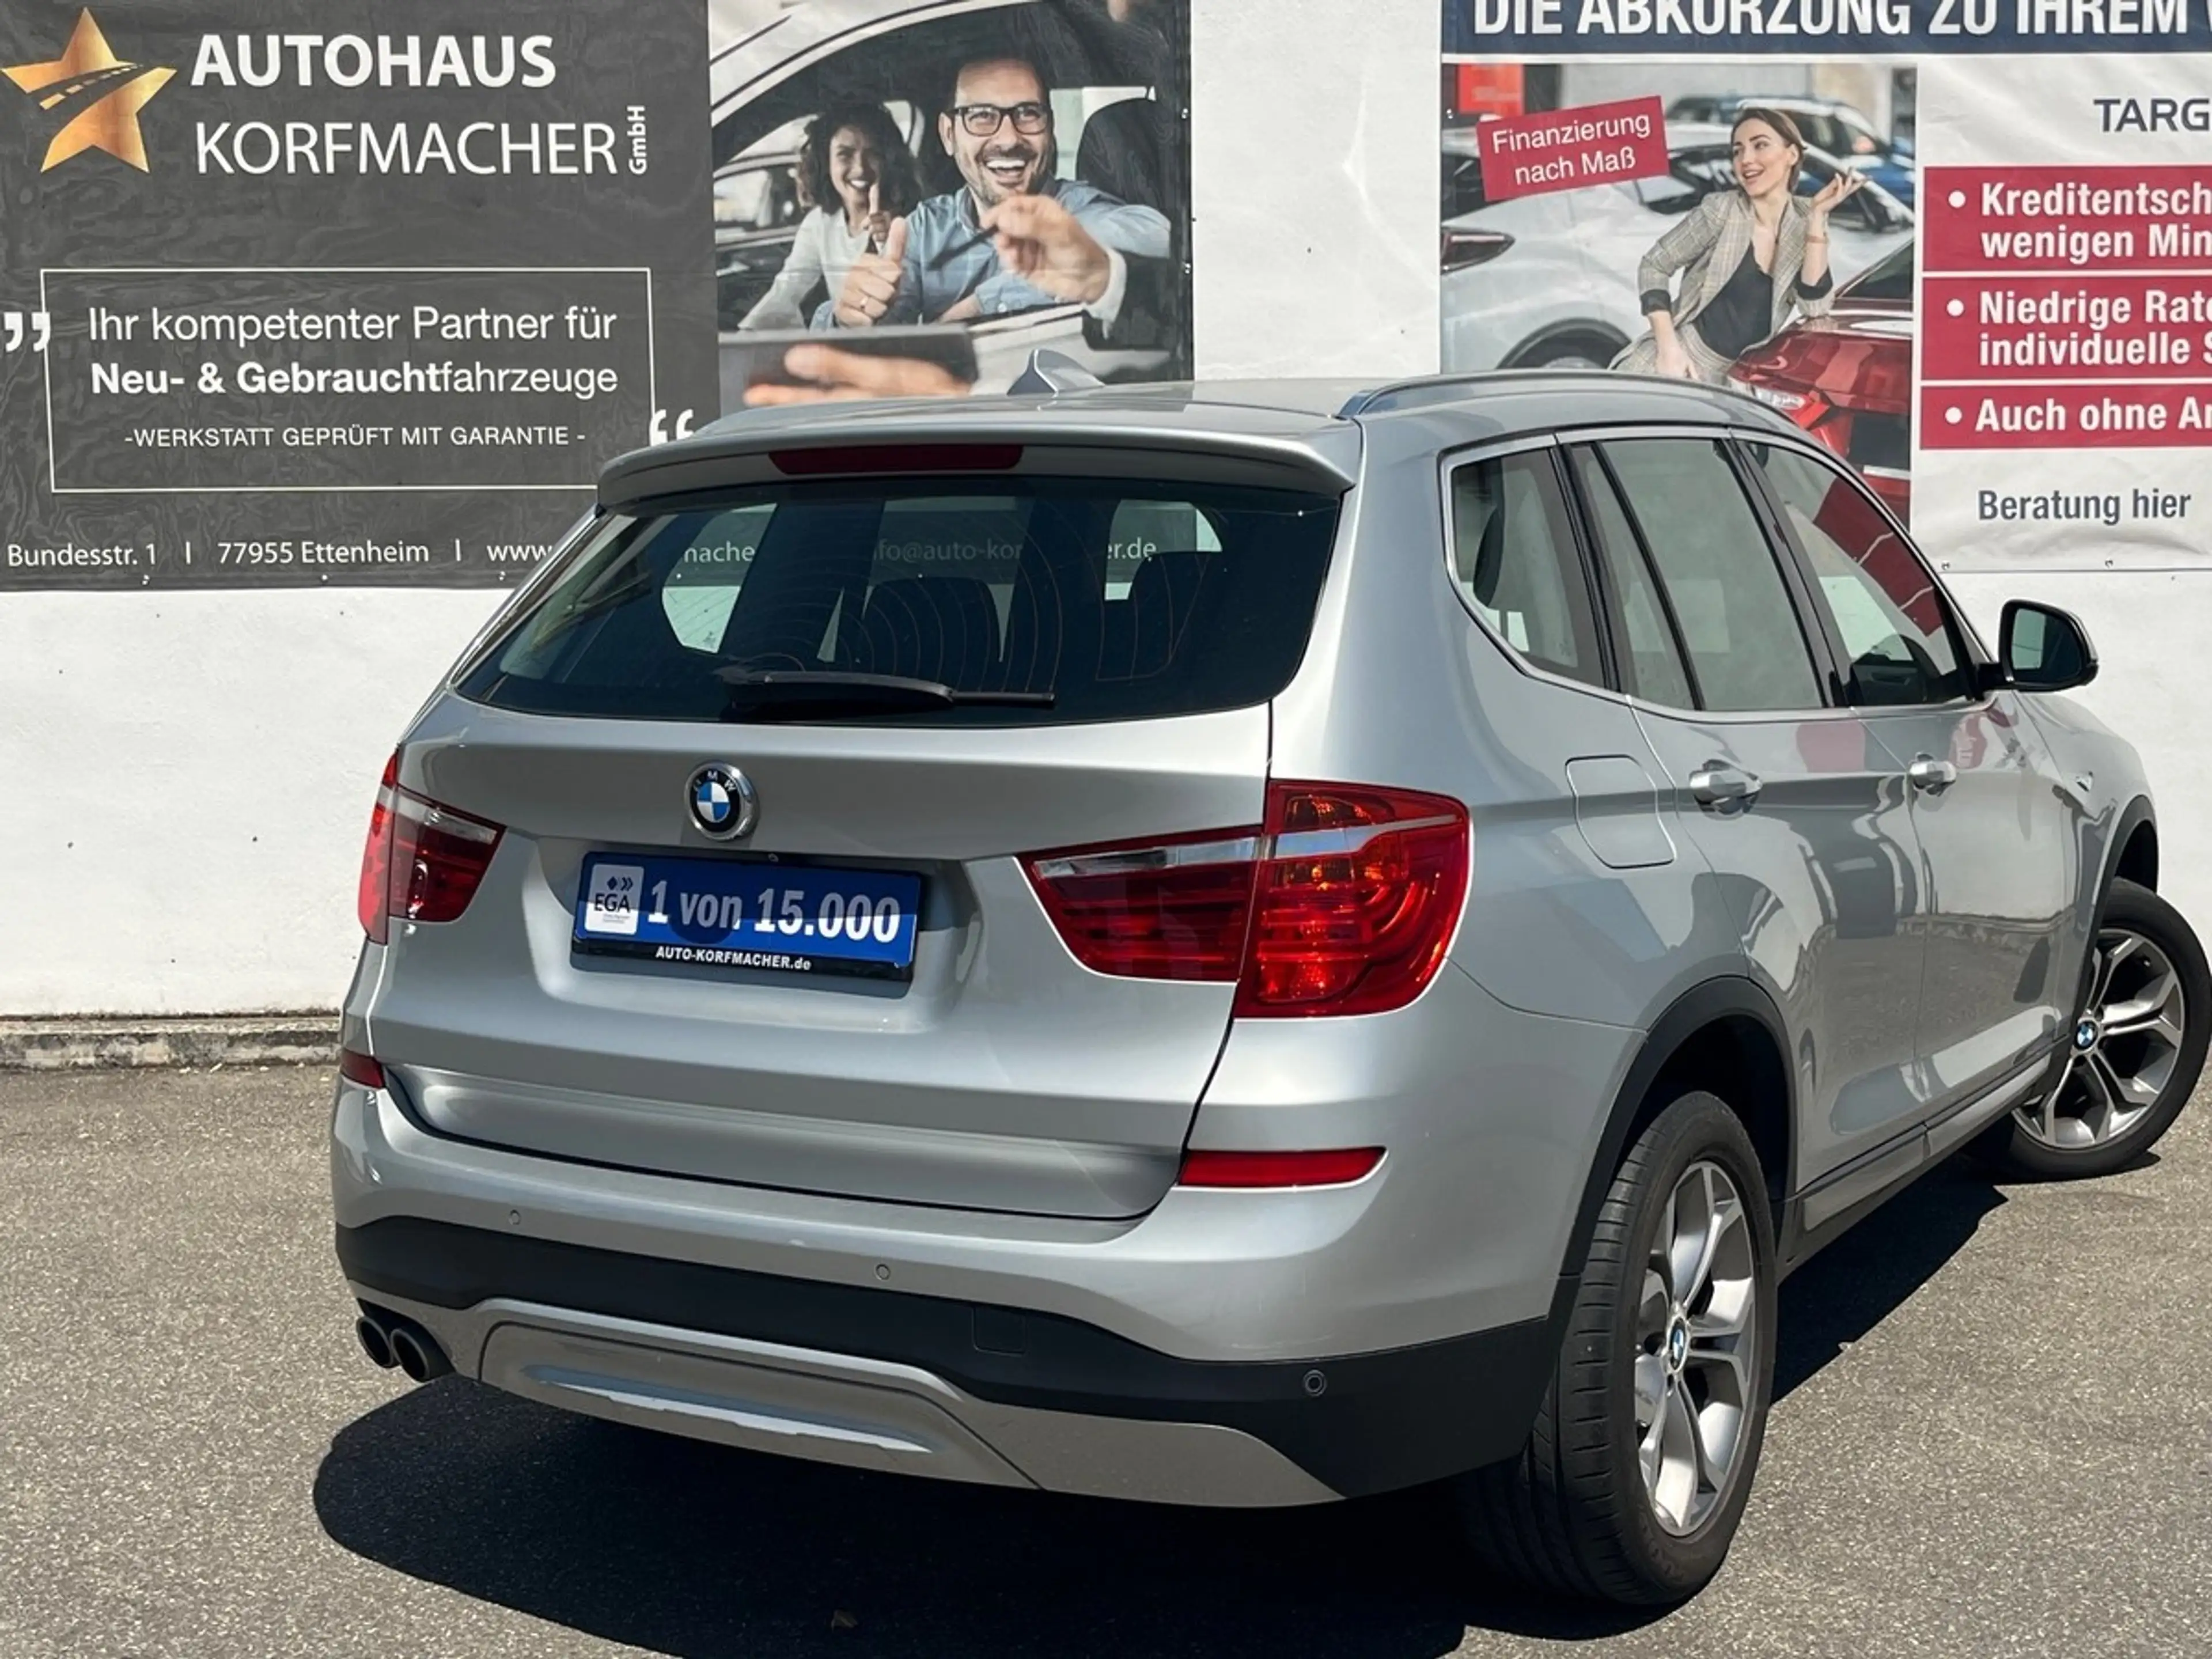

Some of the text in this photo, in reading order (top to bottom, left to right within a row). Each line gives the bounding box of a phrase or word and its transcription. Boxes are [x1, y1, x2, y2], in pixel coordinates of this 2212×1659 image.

[1474, 0, 1563, 35] DIE
[1928, 0, 1997, 35] ZU
[2017, 0, 2188, 35] IHREM
[191, 34, 556, 88] AUTOHAUS
[1493, 112, 1651, 154] Finanzierung
[2093, 98, 2210, 132] TARG
[196, 121, 618, 175] KORFMACHER
[627, 105, 647, 175] GmbH
[1515, 146, 1636, 185] nach Maß
[1982, 181, 2212, 217] Kreditentsch
[1980, 223, 2212, 265] wenigen Min
[89, 305, 618, 349] Ihr kompetenter Partner für
[1980, 290, 2131, 331] Niedrige
[1980, 331, 2191, 366] individuelle
[91, 360, 618, 400] Neu- & Gebrauchtfahrzeuge
[1975, 397, 2066, 431] Auch
[2080, 397, 2168, 431] ohne
[124, 427, 274, 447] -WERKSTATT
[282, 423, 394, 446] GEPRÜFT
[401, 426, 443, 445] MIT
[450, 426, 569, 446] GARANTIE
[1978, 487, 2192, 527] Beratung hier
[7, 542, 138, 567] Bundesstr.
[146, 543, 156, 565] 1
[217, 541, 294, 564] 77955
[301, 539, 429, 564] Ettenheim
[594, 892, 631, 914] EGA
[647, 880, 901, 944] 1 von 15.000
[655, 945, 811, 971] AUTO-KORFMACHER.de
